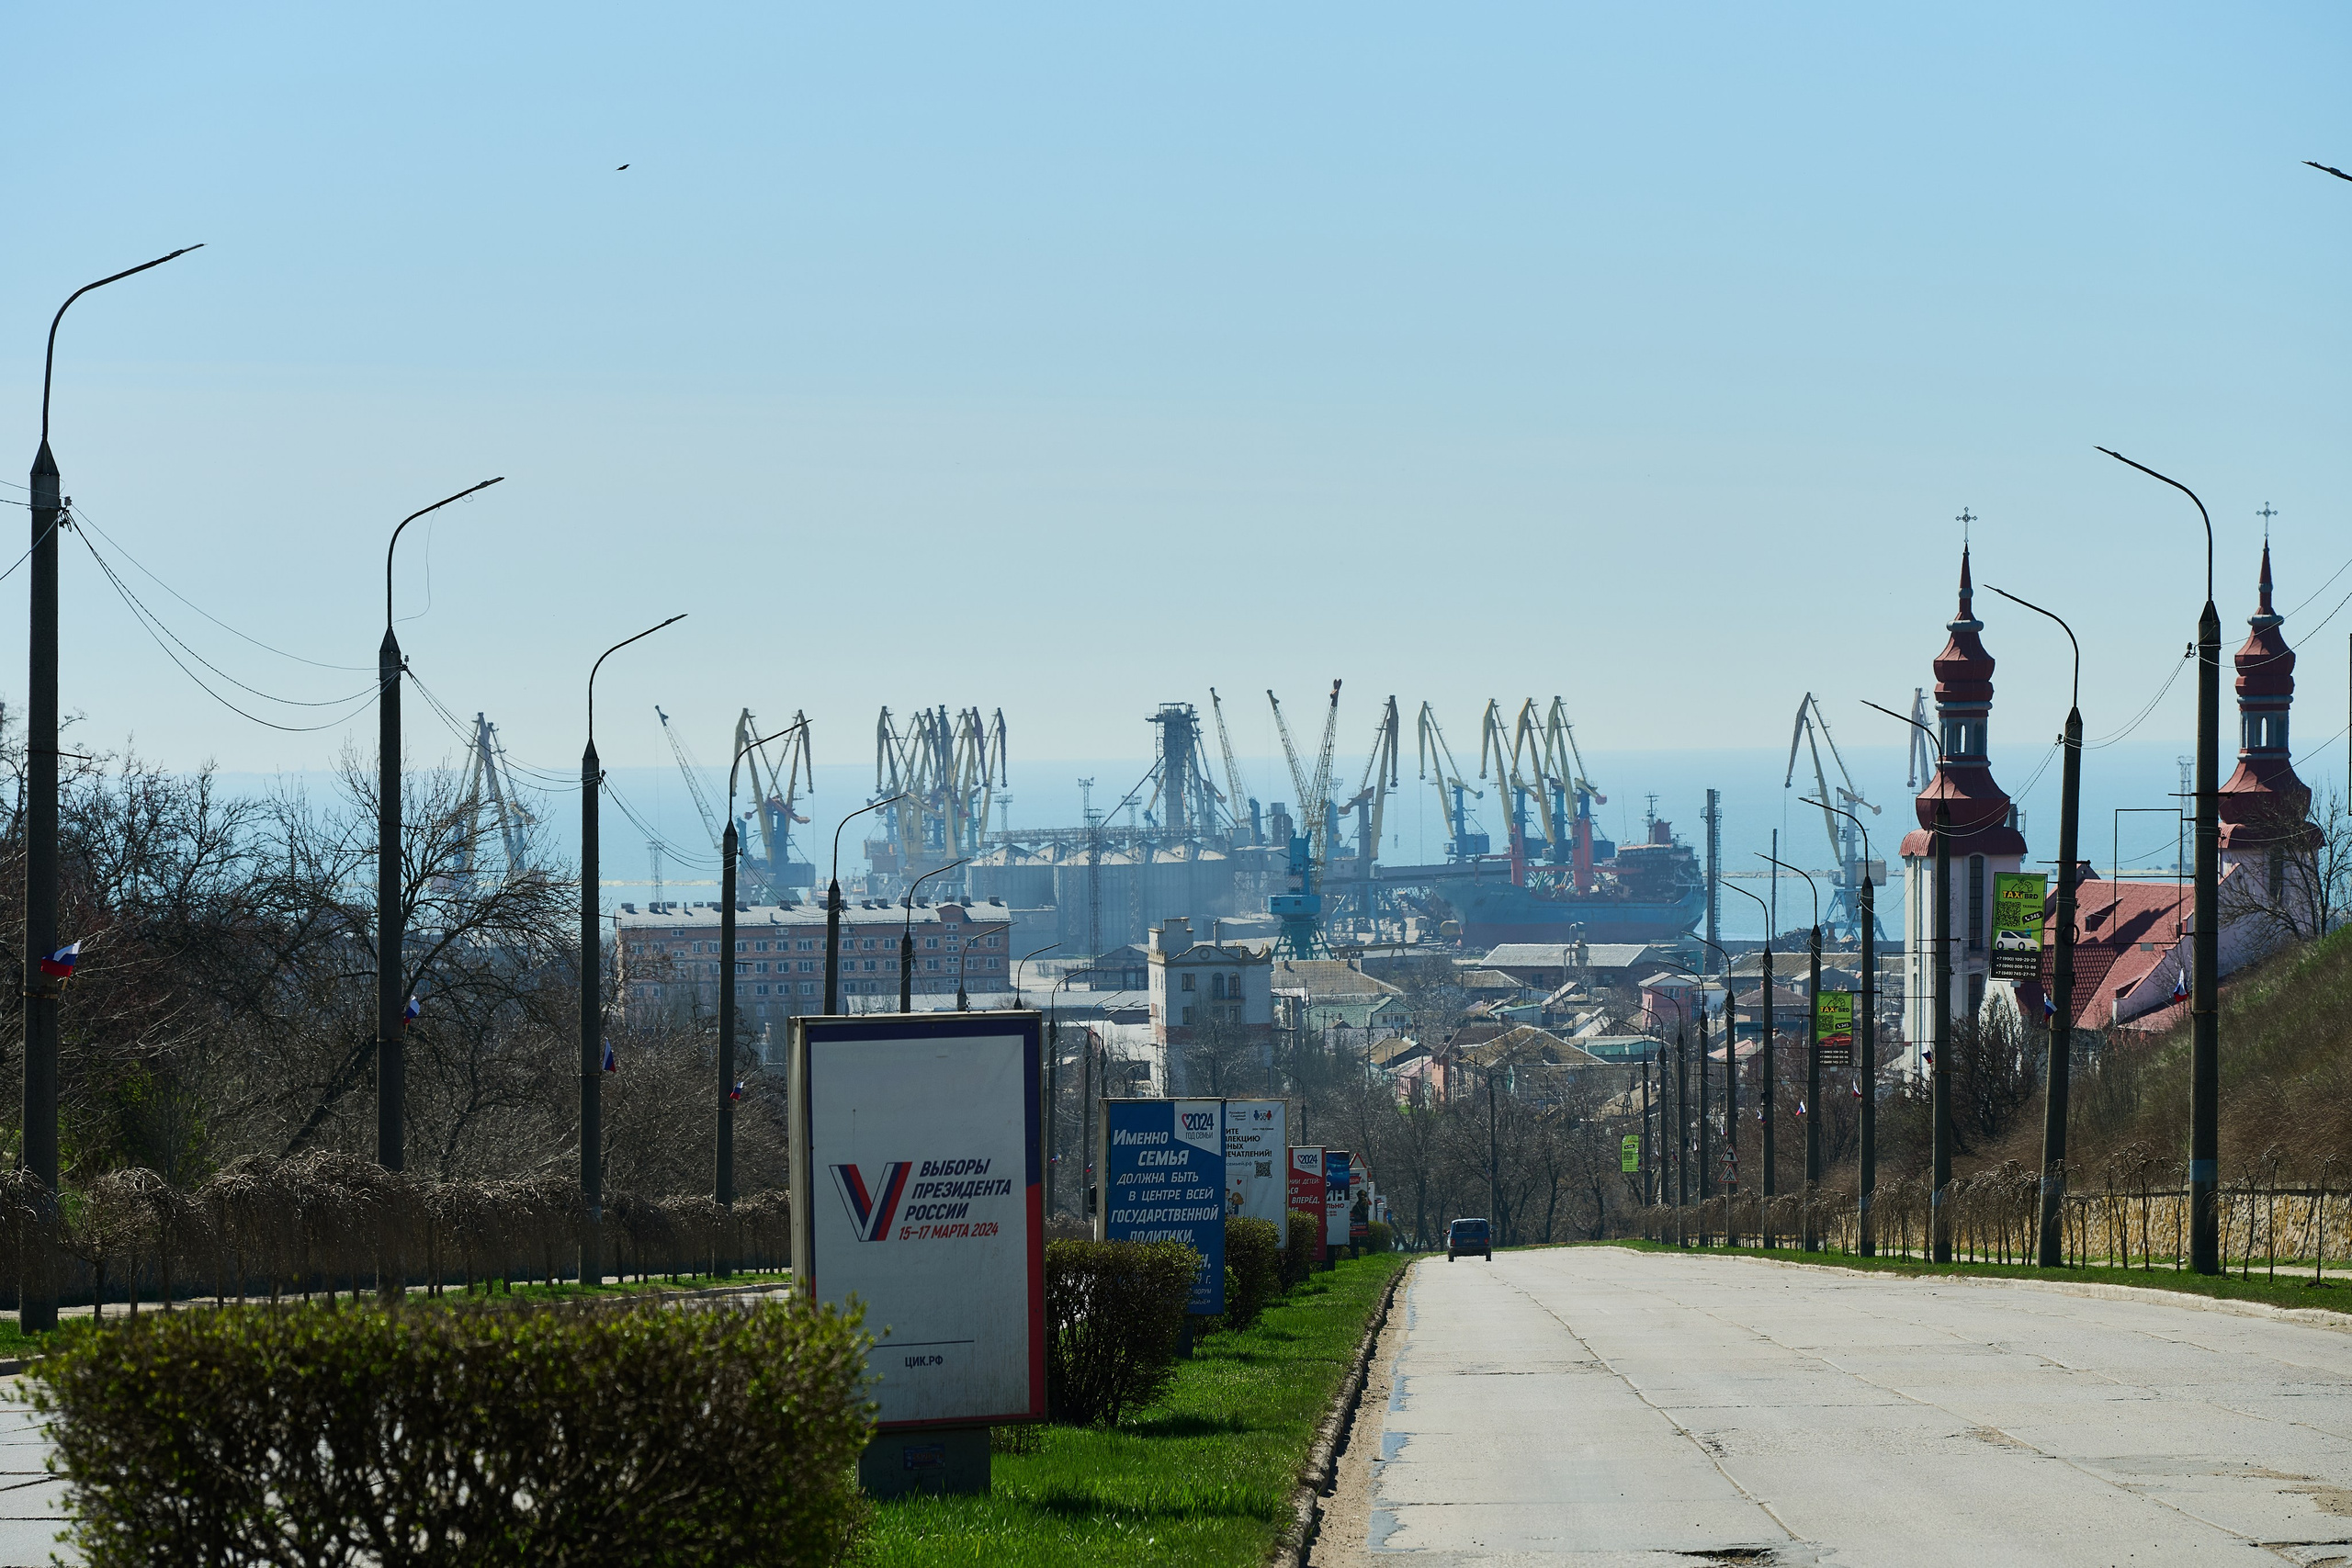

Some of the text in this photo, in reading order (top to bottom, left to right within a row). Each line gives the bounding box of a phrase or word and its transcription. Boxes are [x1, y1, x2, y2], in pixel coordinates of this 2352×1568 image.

[1187, 1112, 1215, 1131] 2024
[1185, 1131, 1214, 1140] ГОД СЕМЬИ
[1137, 1149, 1190, 1167] СЕМЬЯ
[1301, 1154, 1318, 1165] 2024
[919, 1158, 991, 1178] ВЫБОРЫ
[1116, 1171, 1199, 1186] ДОЛЖНА БЫТЬ
[911, 1179, 1012, 1200] ПРЕЗИДЕНТА
[1128, 1186, 1215, 1202] В ЦЕНТРЕ ВСЕЙ
[1291, 1194, 1320, 1204] ВПЕРЁД.
[903, 1202, 970, 1222] РОССИИ
[1111, 1203, 1219, 1224] ГОСУДАРСТВЕННОЙ
[931, 1224, 969, 1239] МАРТА
[970, 1222, 1000, 1237] 2024
[904, 1355, 944, 1369] ЦИК.РФ
